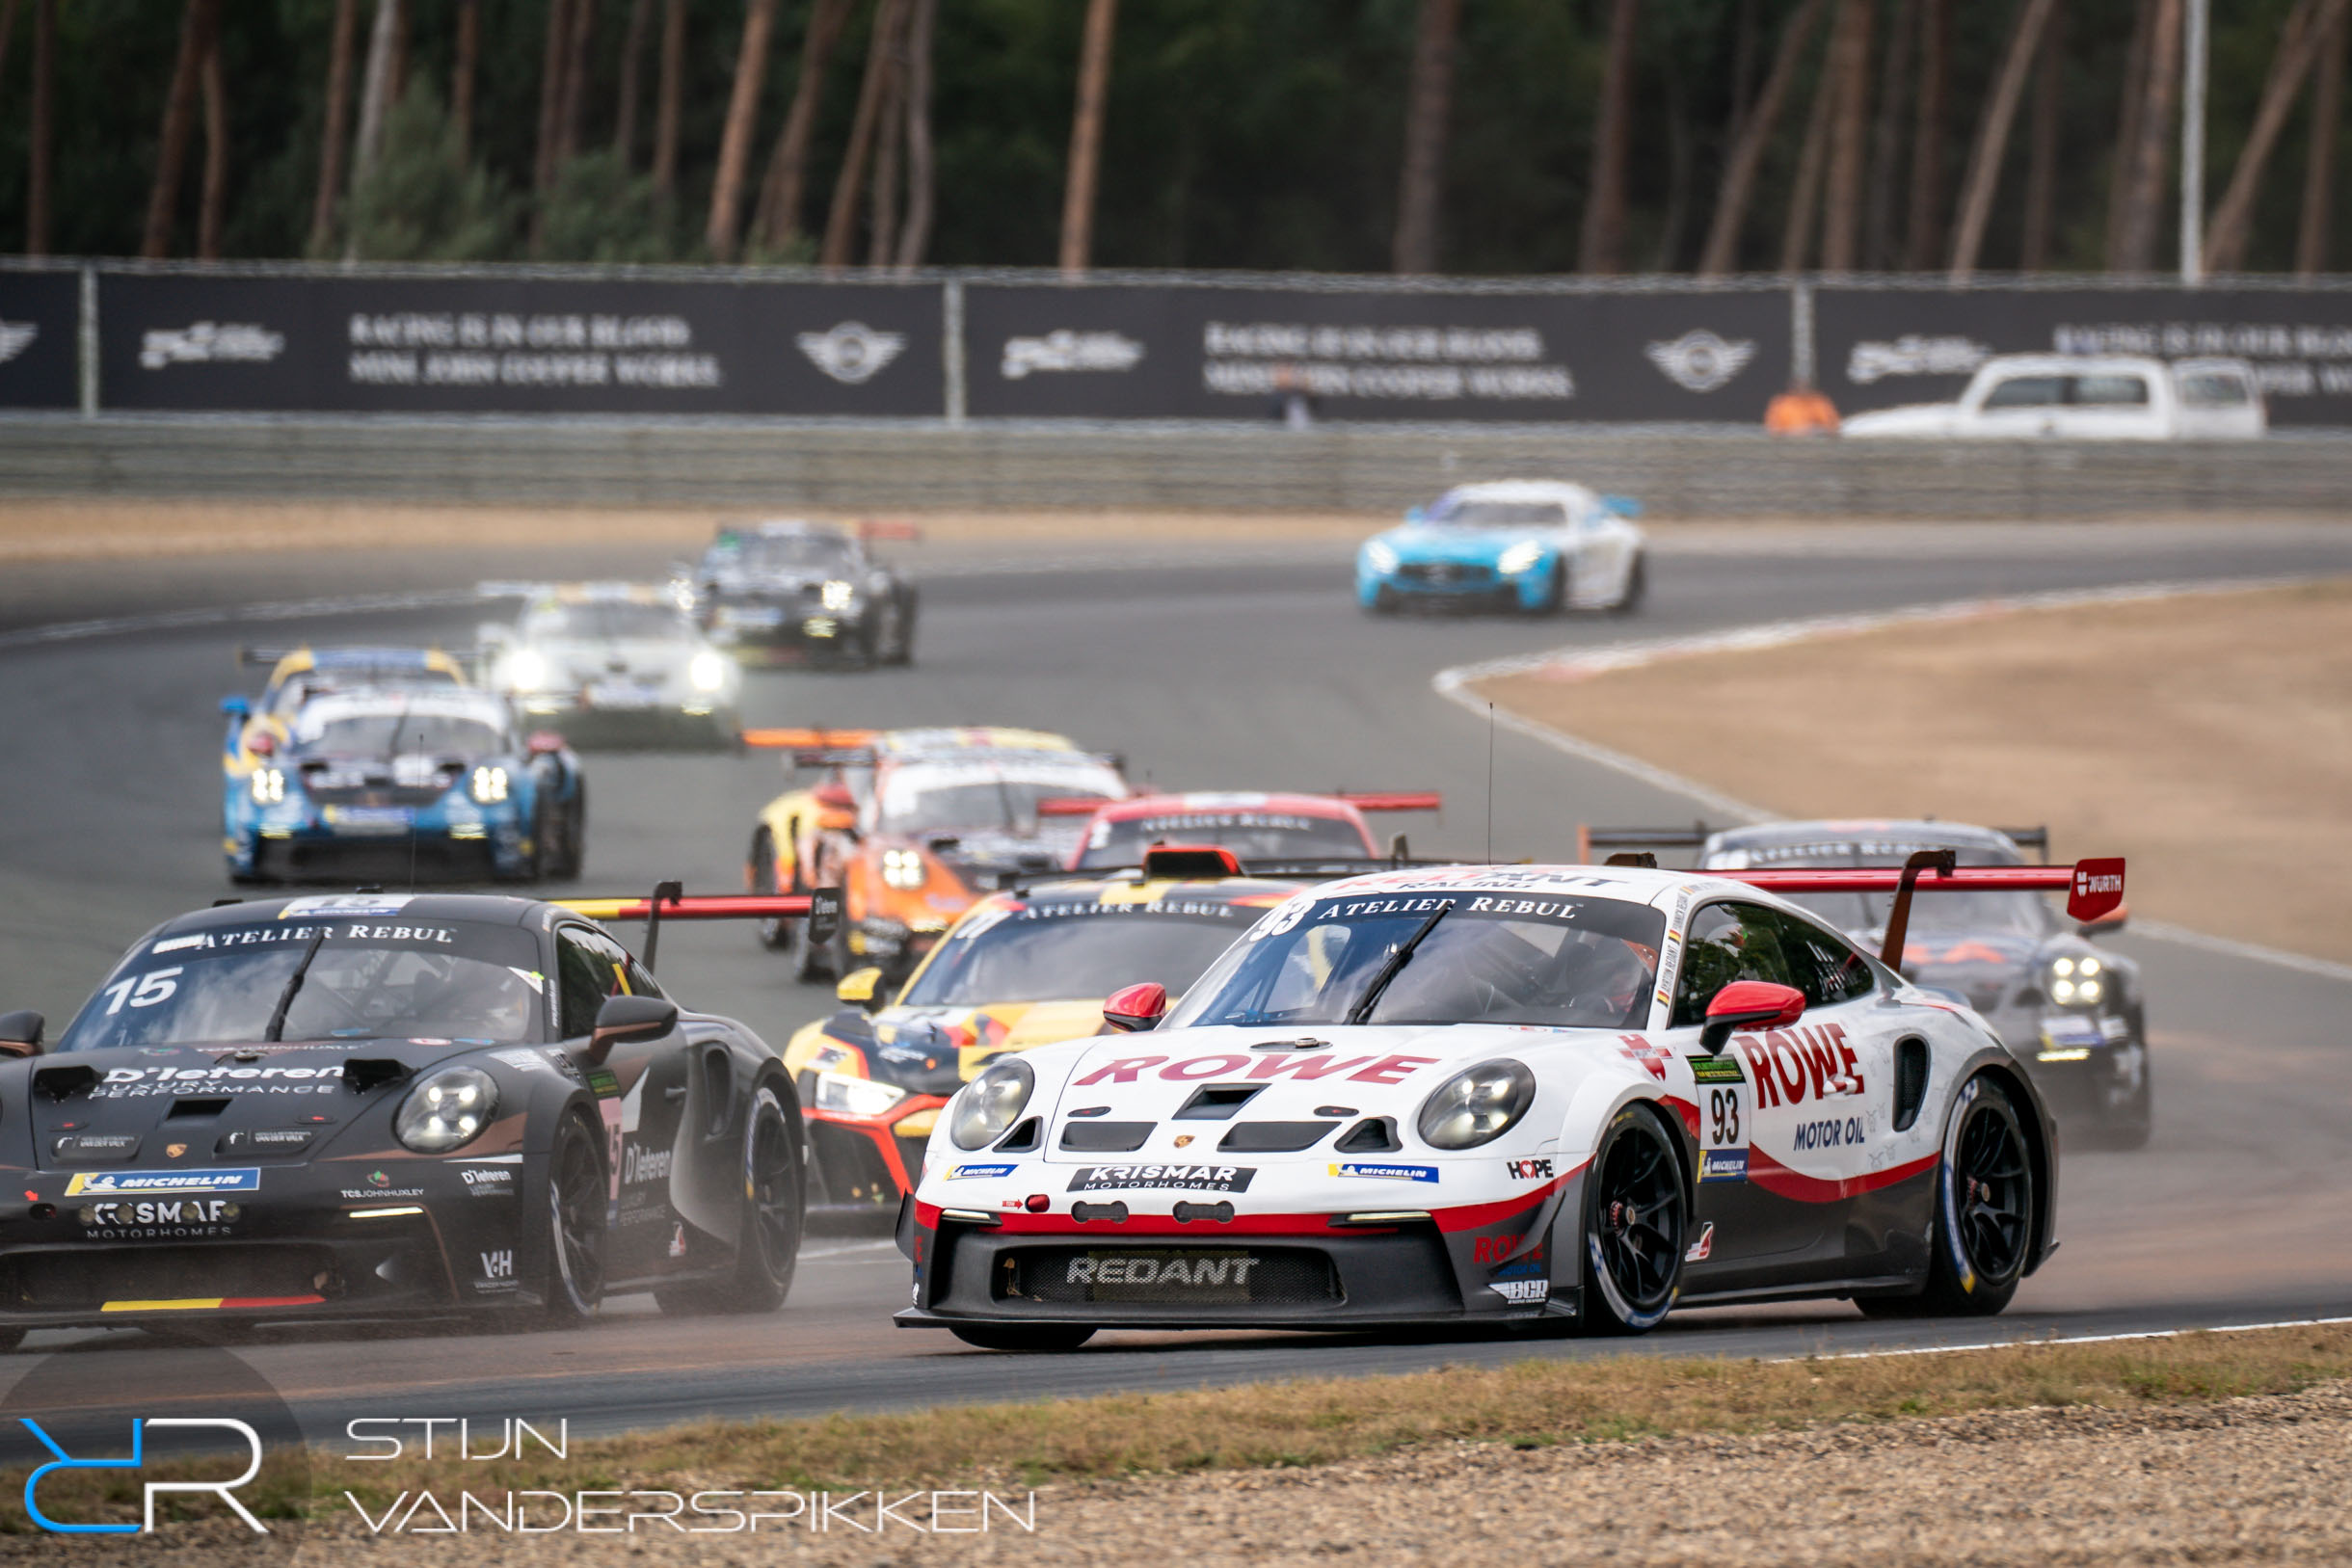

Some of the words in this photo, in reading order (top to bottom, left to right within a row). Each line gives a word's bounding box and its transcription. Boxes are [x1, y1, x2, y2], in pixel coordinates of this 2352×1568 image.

[1249, 898, 1317, 943] 93
[1318, 898, 1457, 920] ATELIER
[1469, 896, 1576, 920] REBUL
[195, 926, 332, 950] ATELIER
[346, 924, 453, 943] REBUL
[104, 966, 184, 1016] 15
[1072, 1053, 1442, 1086] ROWE
[1732, 1023, 1865, 1110] ROWE
[88, 1084, 335, 1100] PERFORMANCE
[1711, 1088, 1740, 1146] 93
[1793, 1120, 1842, 1152] MOTOR
[1845, 1117, 1865, 1145] OIL
[120, 1175, 243, 1188] MICHELIN
[1087, 1165, 1238, 1182] KRISMAR
[1359, 1167, 1428, 1179] MICHELIN
[1507, 1158, 1554, 1180] HOPE
[1083, 1181, 1230, 1192] MOTORHOMES
[87, 1226, 231, 1239] MOTORHOMES
[1066, 1257, 1259, 1285] REDANT
